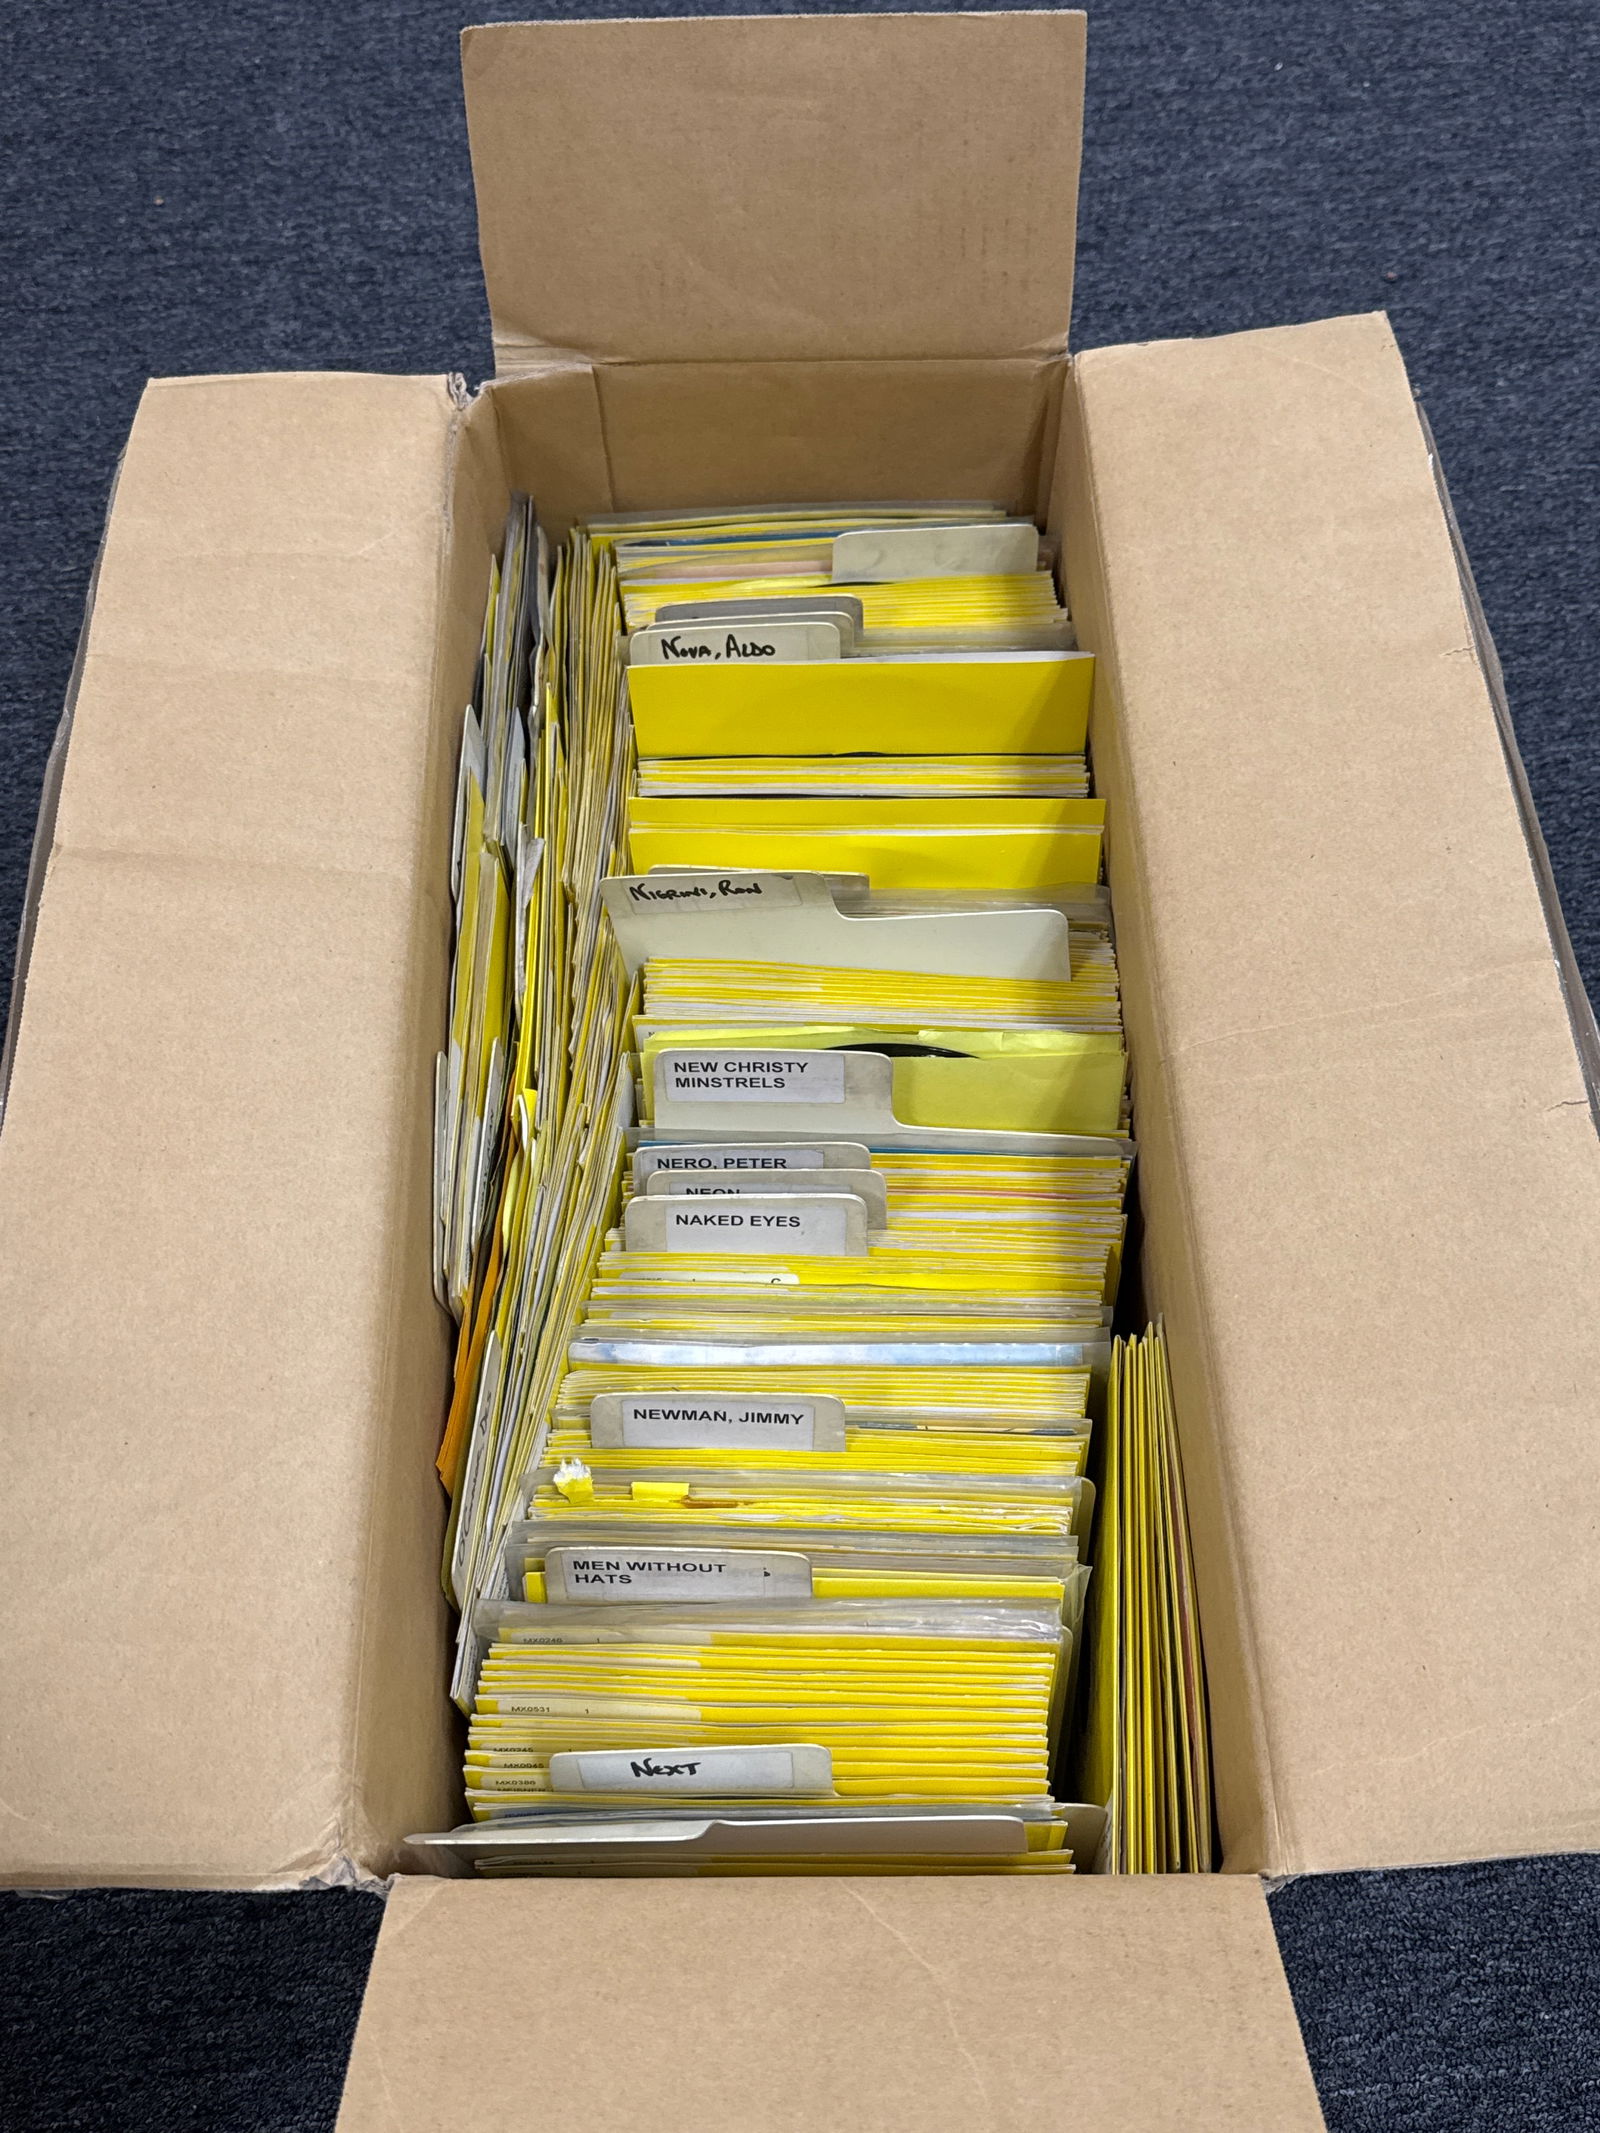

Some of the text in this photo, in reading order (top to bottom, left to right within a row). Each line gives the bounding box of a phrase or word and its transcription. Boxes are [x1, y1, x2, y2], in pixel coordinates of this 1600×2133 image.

[673, 1061, 809, 1073] NEW CHRISTY
[675, 1077, 786, 1089] MINSTRELS
[656, 1157, 787, 1170] NERO, PETER
[675, 1214, 801, 1227] NAKED EYES
[633, 1408, 805, 1425] NEWMAN, JIMMY
[572, 1560, 727, 1573] MEN WITHOUT
[574, 1574, 632, 1584] HATS
